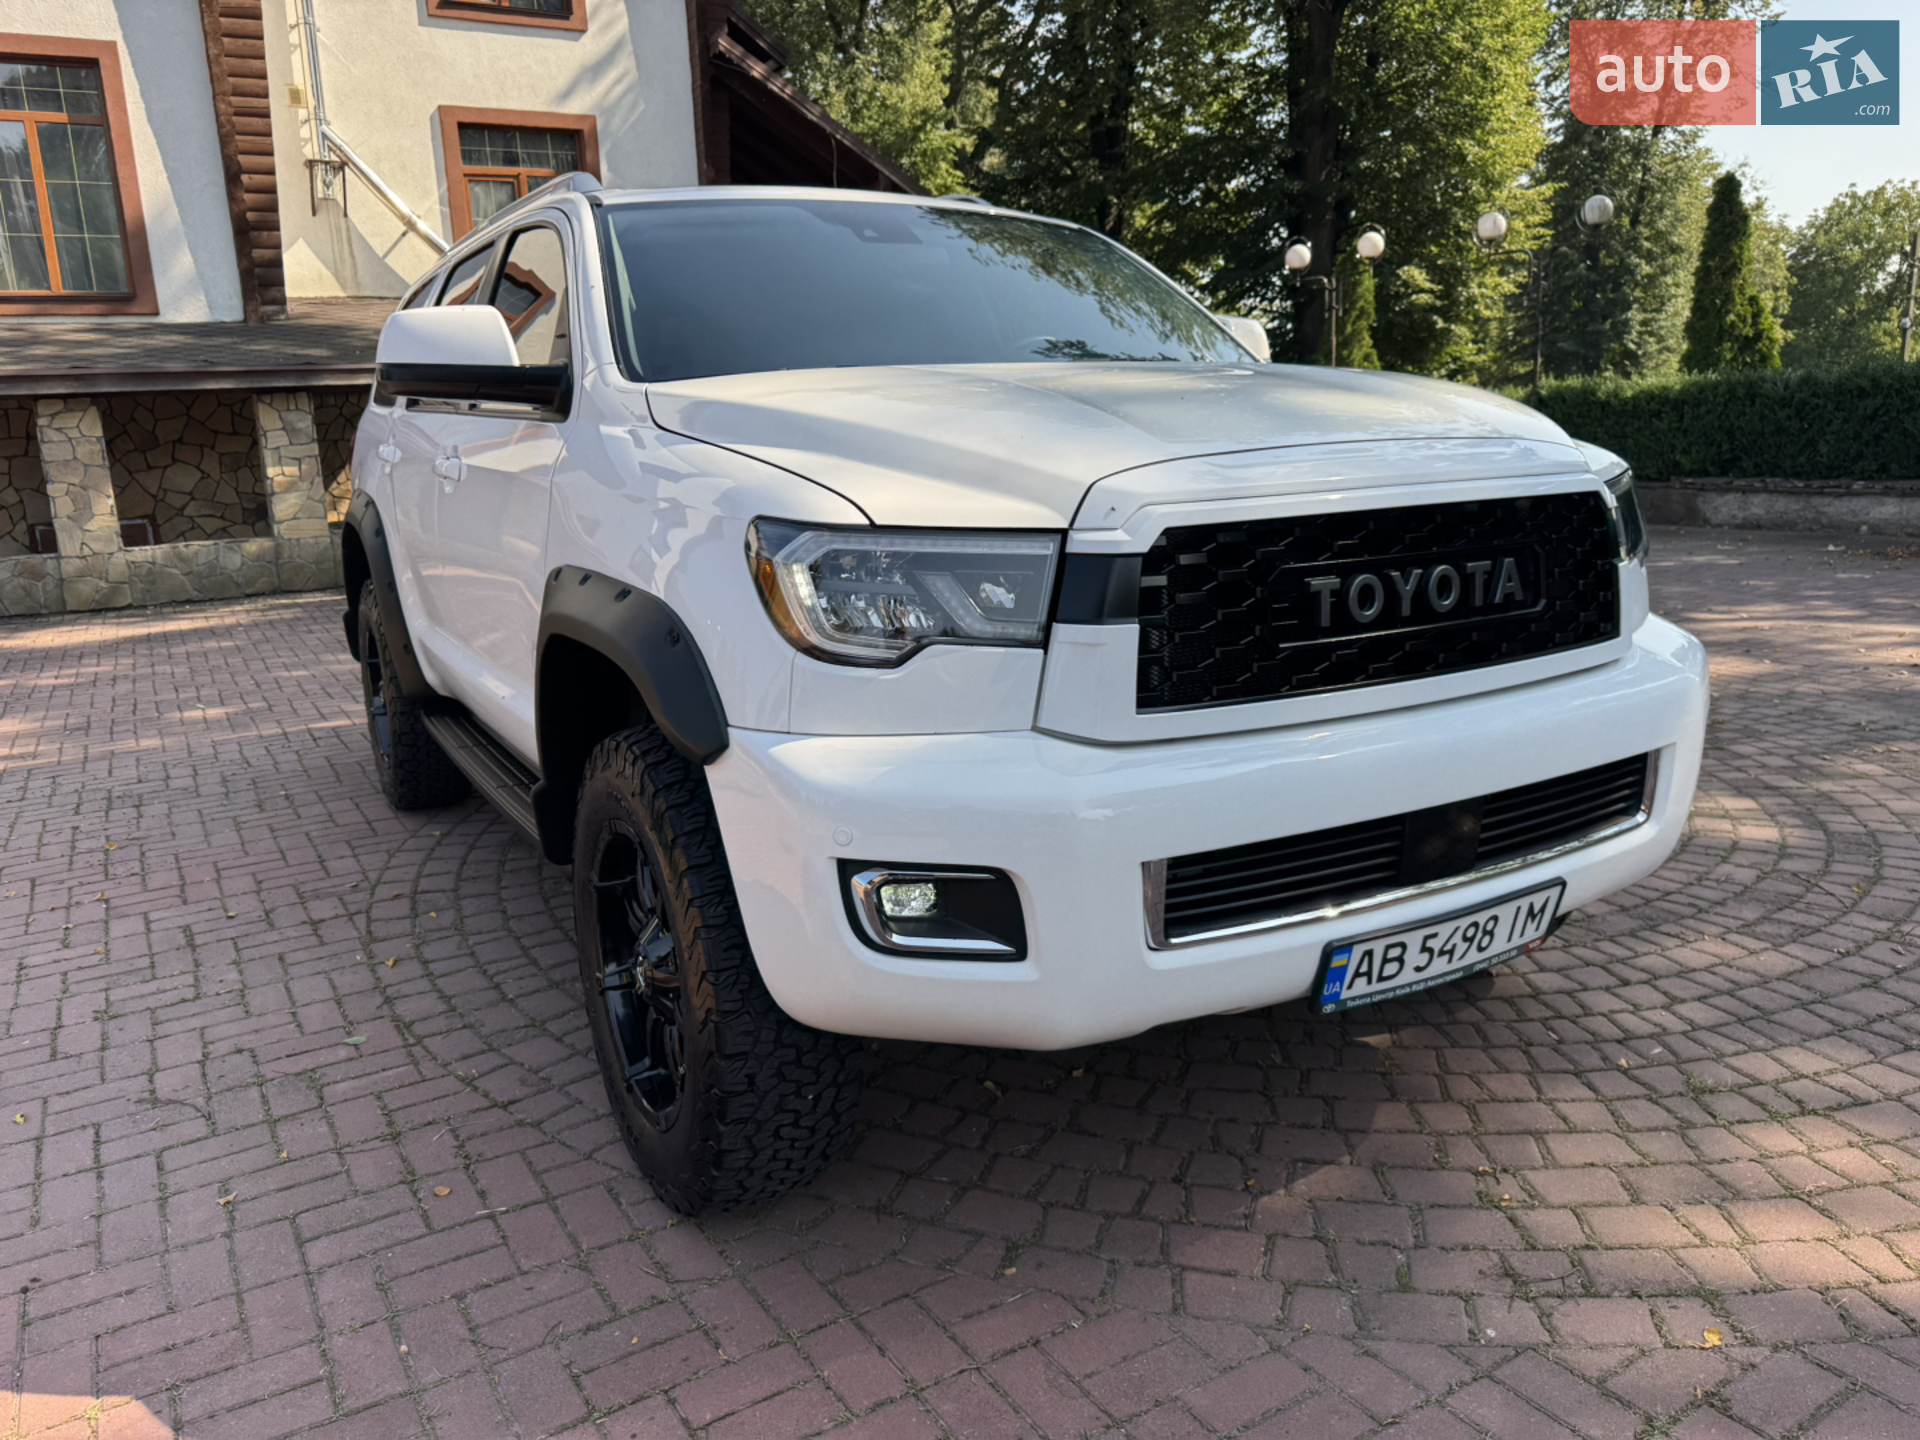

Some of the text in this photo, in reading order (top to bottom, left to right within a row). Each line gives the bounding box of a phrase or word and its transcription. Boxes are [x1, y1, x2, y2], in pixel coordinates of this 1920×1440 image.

[1307, 557, 1524, 627] TOYOTA
[1346, 895, 1551, 990] AB 5498 IM
[1323, 981, 1341, 996] UA
